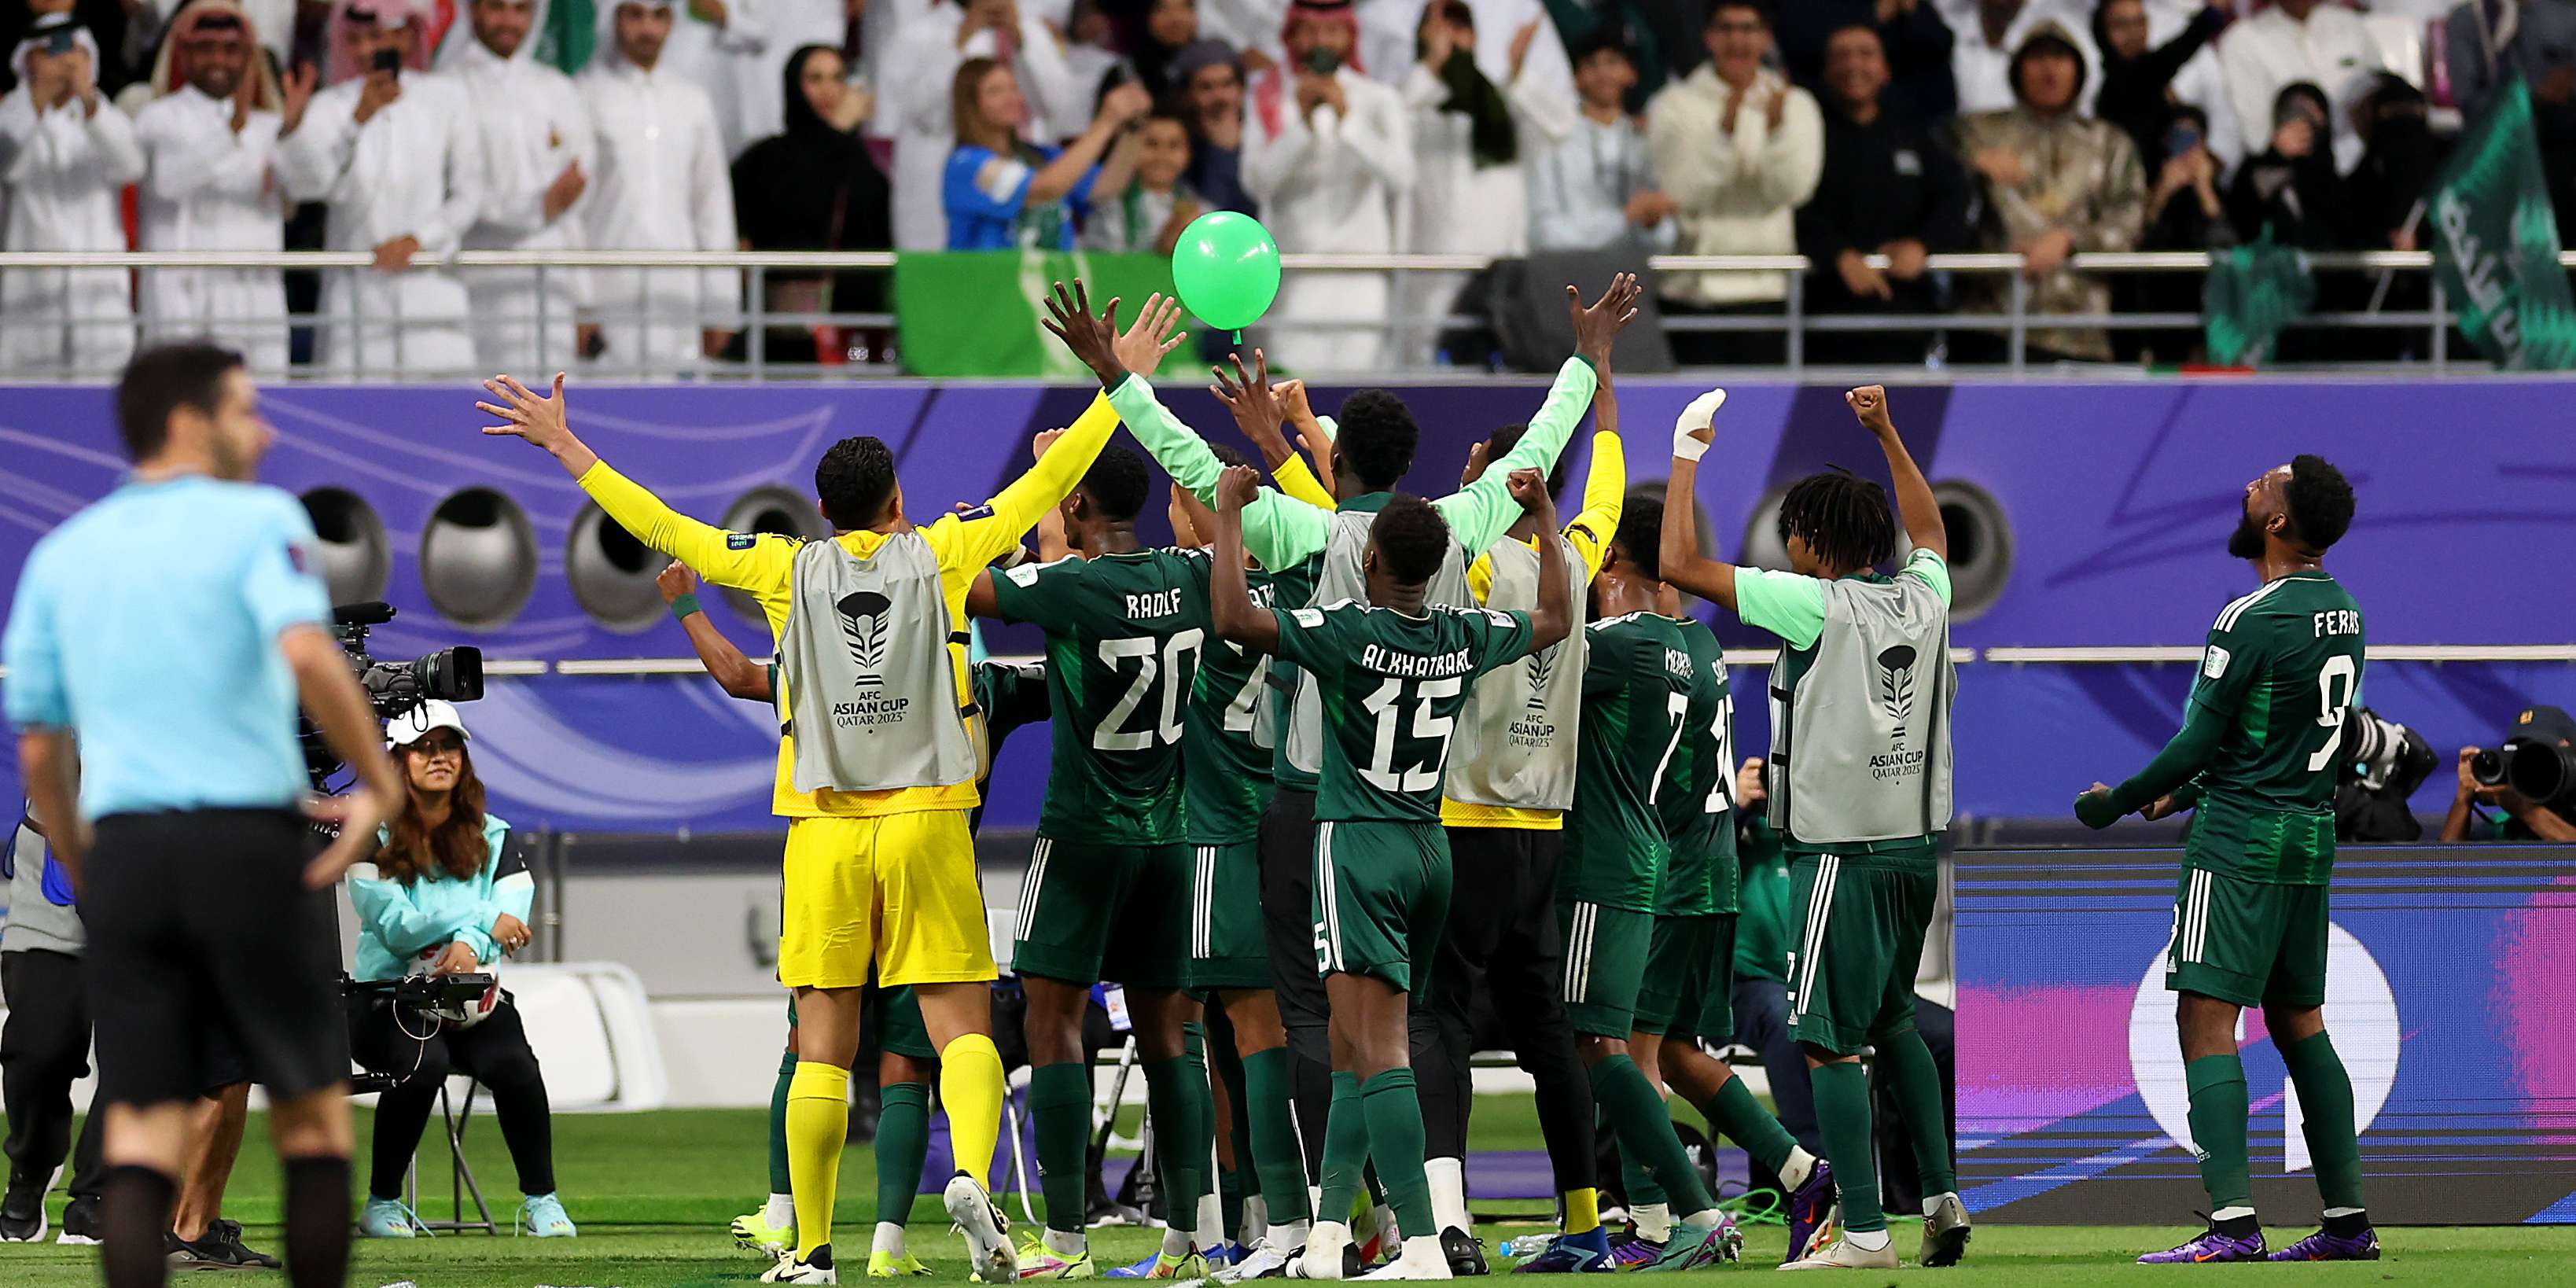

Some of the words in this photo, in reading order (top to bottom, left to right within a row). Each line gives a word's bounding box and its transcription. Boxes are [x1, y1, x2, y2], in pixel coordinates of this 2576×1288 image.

[1126, 588, 1181, 619] RADIF
[2314, 610, 2359, 638] FERAS
[1362, 643, 1474, 676] ALKHAIBARI
[859, 691, 881, 701] AFC
[1093, 628, 1205, 750] 20
[833, 702, 878, 715] ASIAN
[880, 697, 909, 712] CUP
[2308, 654, 2356, 771] 9
[837, 715, 874, 728] QATAR
[877, 712, 903, 723] 2023
[1525, 714, 1543, 724] AFC
[1357, 675, 1463, 792] 15
[1509, 721, 1540, 737] ASIAN
[1540, 725, 1555, 736] UP
[1509, 735, 1535, 748] QATAR
[1649, 691, 1689, 805] 7
[1891, 742, 1904, 753] AFC
[1868, 753, 1903, 767] ASIAN
[1904, 750, 1923, 764] CUP
[1872, 767, 1901, 781] QATAR
